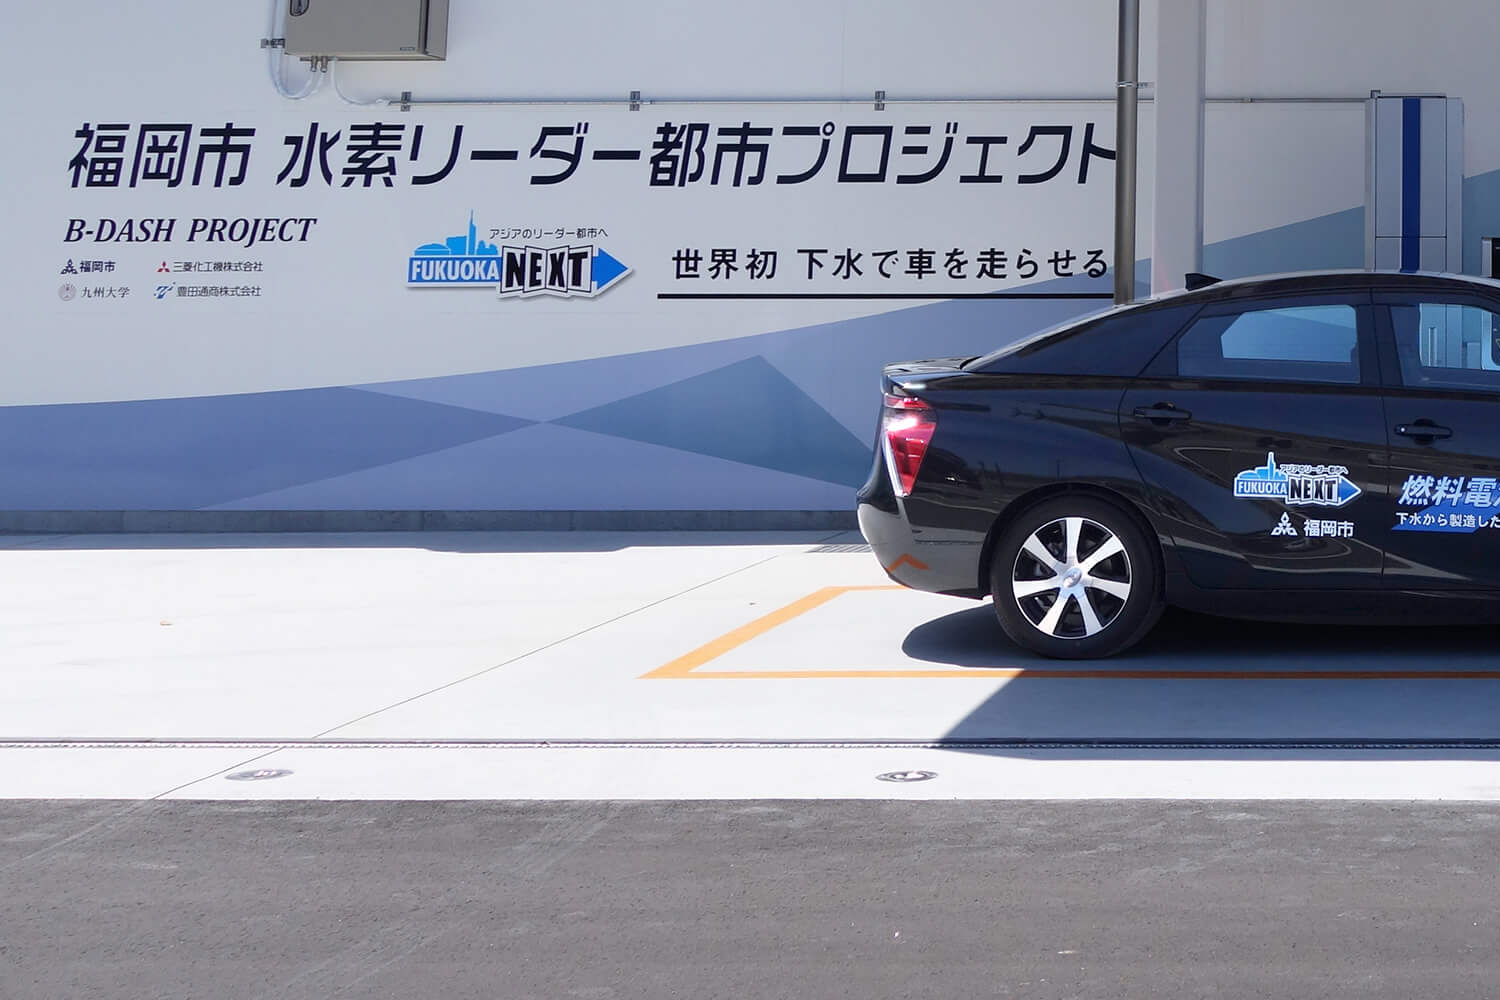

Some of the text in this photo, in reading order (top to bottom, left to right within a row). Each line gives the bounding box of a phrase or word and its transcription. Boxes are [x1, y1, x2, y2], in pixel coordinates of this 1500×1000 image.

[68, 121, 1117, 189] 福岡市 水素リーダー都市プロジェクト
[63, 217, 318, 248] B-DASH PROJECT
[489, 227, 609, 240] アジアのリーダー都市へ
[79, 260, 116, 273] 福岡市
[173, 261, 264, 273] 三菱化工機株式会社
[411, 251, 588, 289] FUKUOKA NEXT
[671, 247, 1109, 280] 世界初 下水で車を走らせる
[81, 286, 131, 299] 九州大学
[1238, 478, 1337, 501] FUKUOKA NEXT
[1303, 519, 1355, 538] 福岡市
